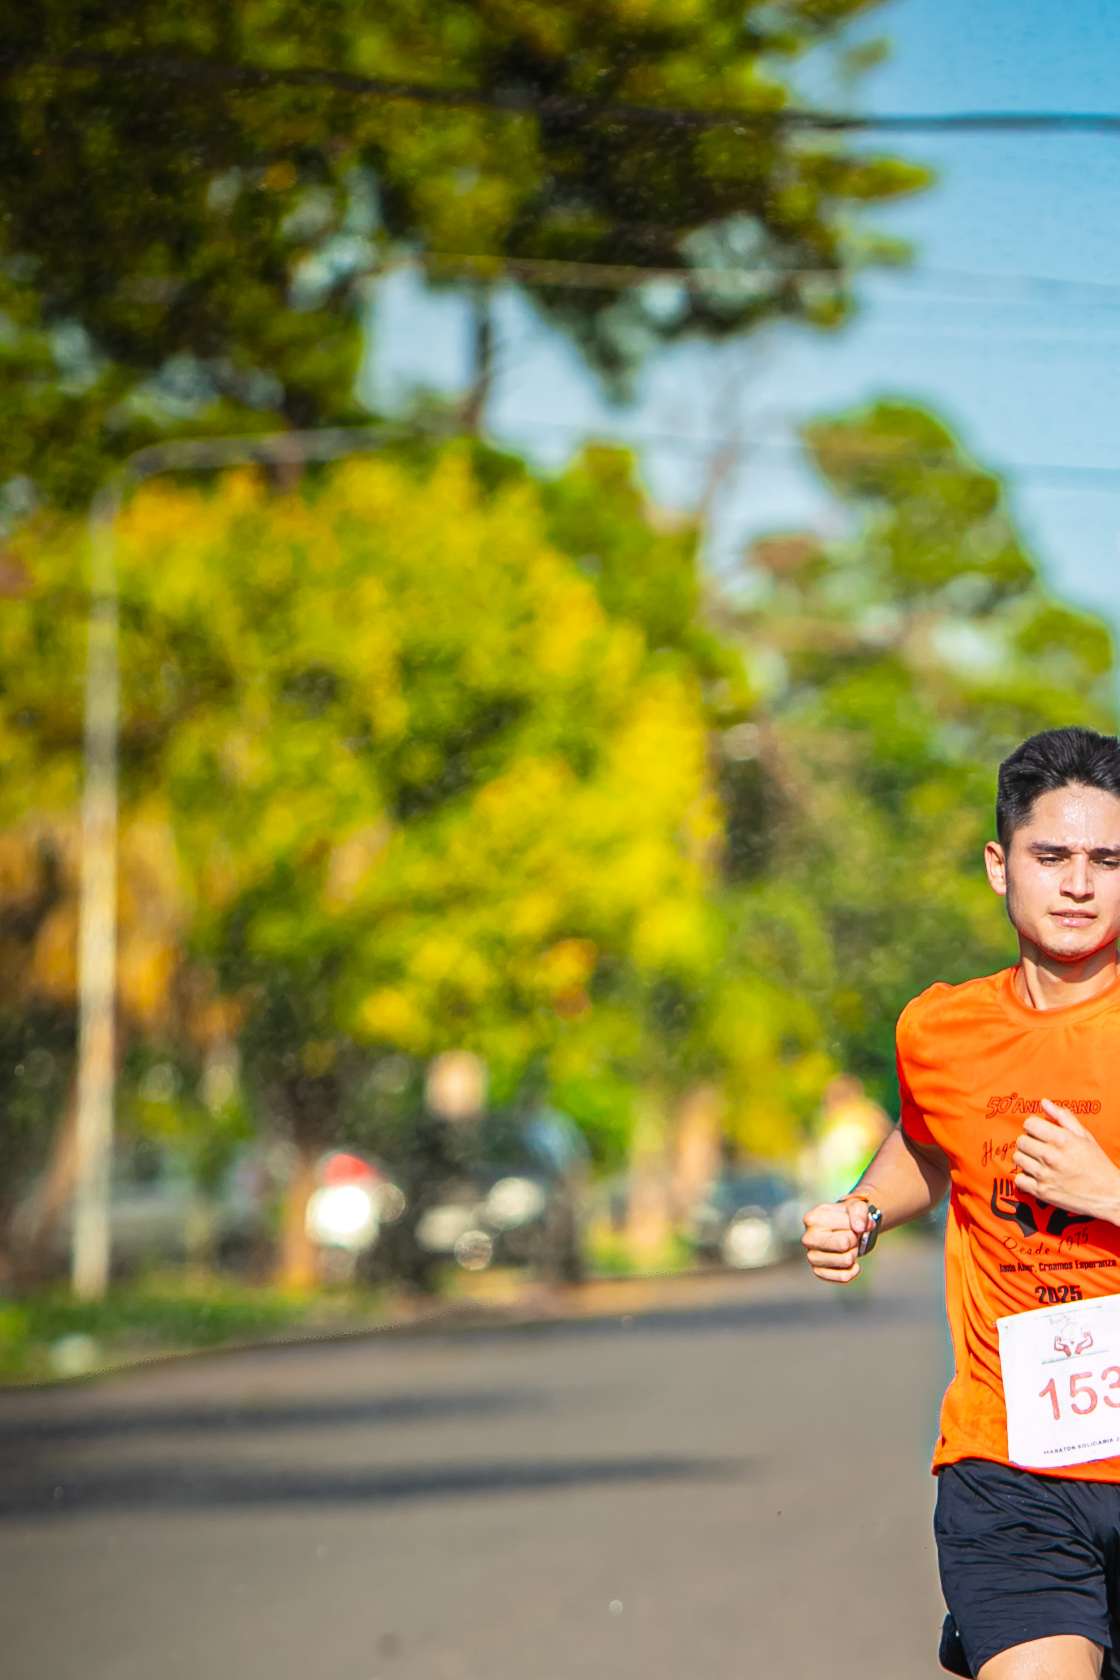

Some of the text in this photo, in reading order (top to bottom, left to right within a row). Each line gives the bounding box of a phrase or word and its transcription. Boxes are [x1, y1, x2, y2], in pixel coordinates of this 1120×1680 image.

[981, 1138, 1017, 1167] Hoga
[1003, 1227, 1089, 1256] Desde 1975
[1038, 1261, 1073, 1272] Creamos
[1074, 1259, 1117, 1270] Esperanza
[1034, 1285, 1083, 1304] 2025
[1077, 1438, 1114, 1449] SOLIDARIA
